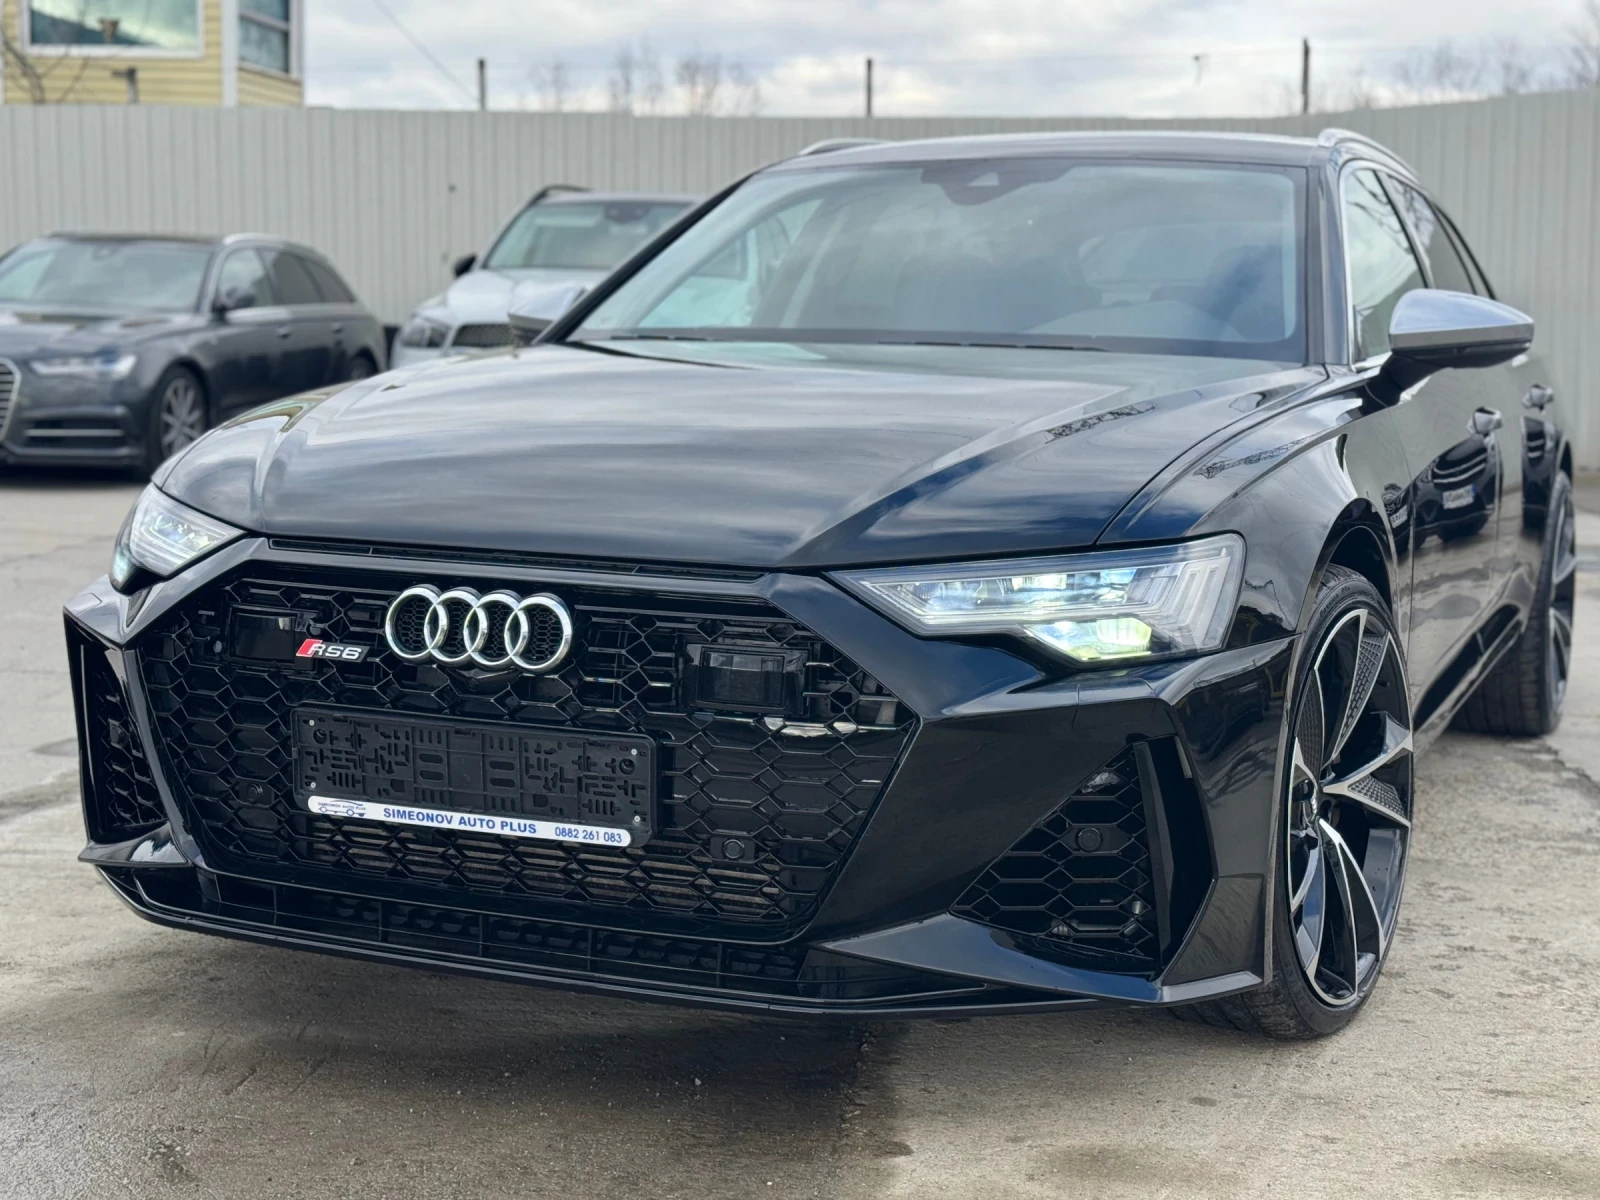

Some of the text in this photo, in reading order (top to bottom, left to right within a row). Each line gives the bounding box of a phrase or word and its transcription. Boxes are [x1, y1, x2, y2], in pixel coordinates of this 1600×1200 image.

[307, 643, 362, 660] RS6
[383, 807, 622, 844] SIMEONOV AUTO PLUS 0882 261 083
